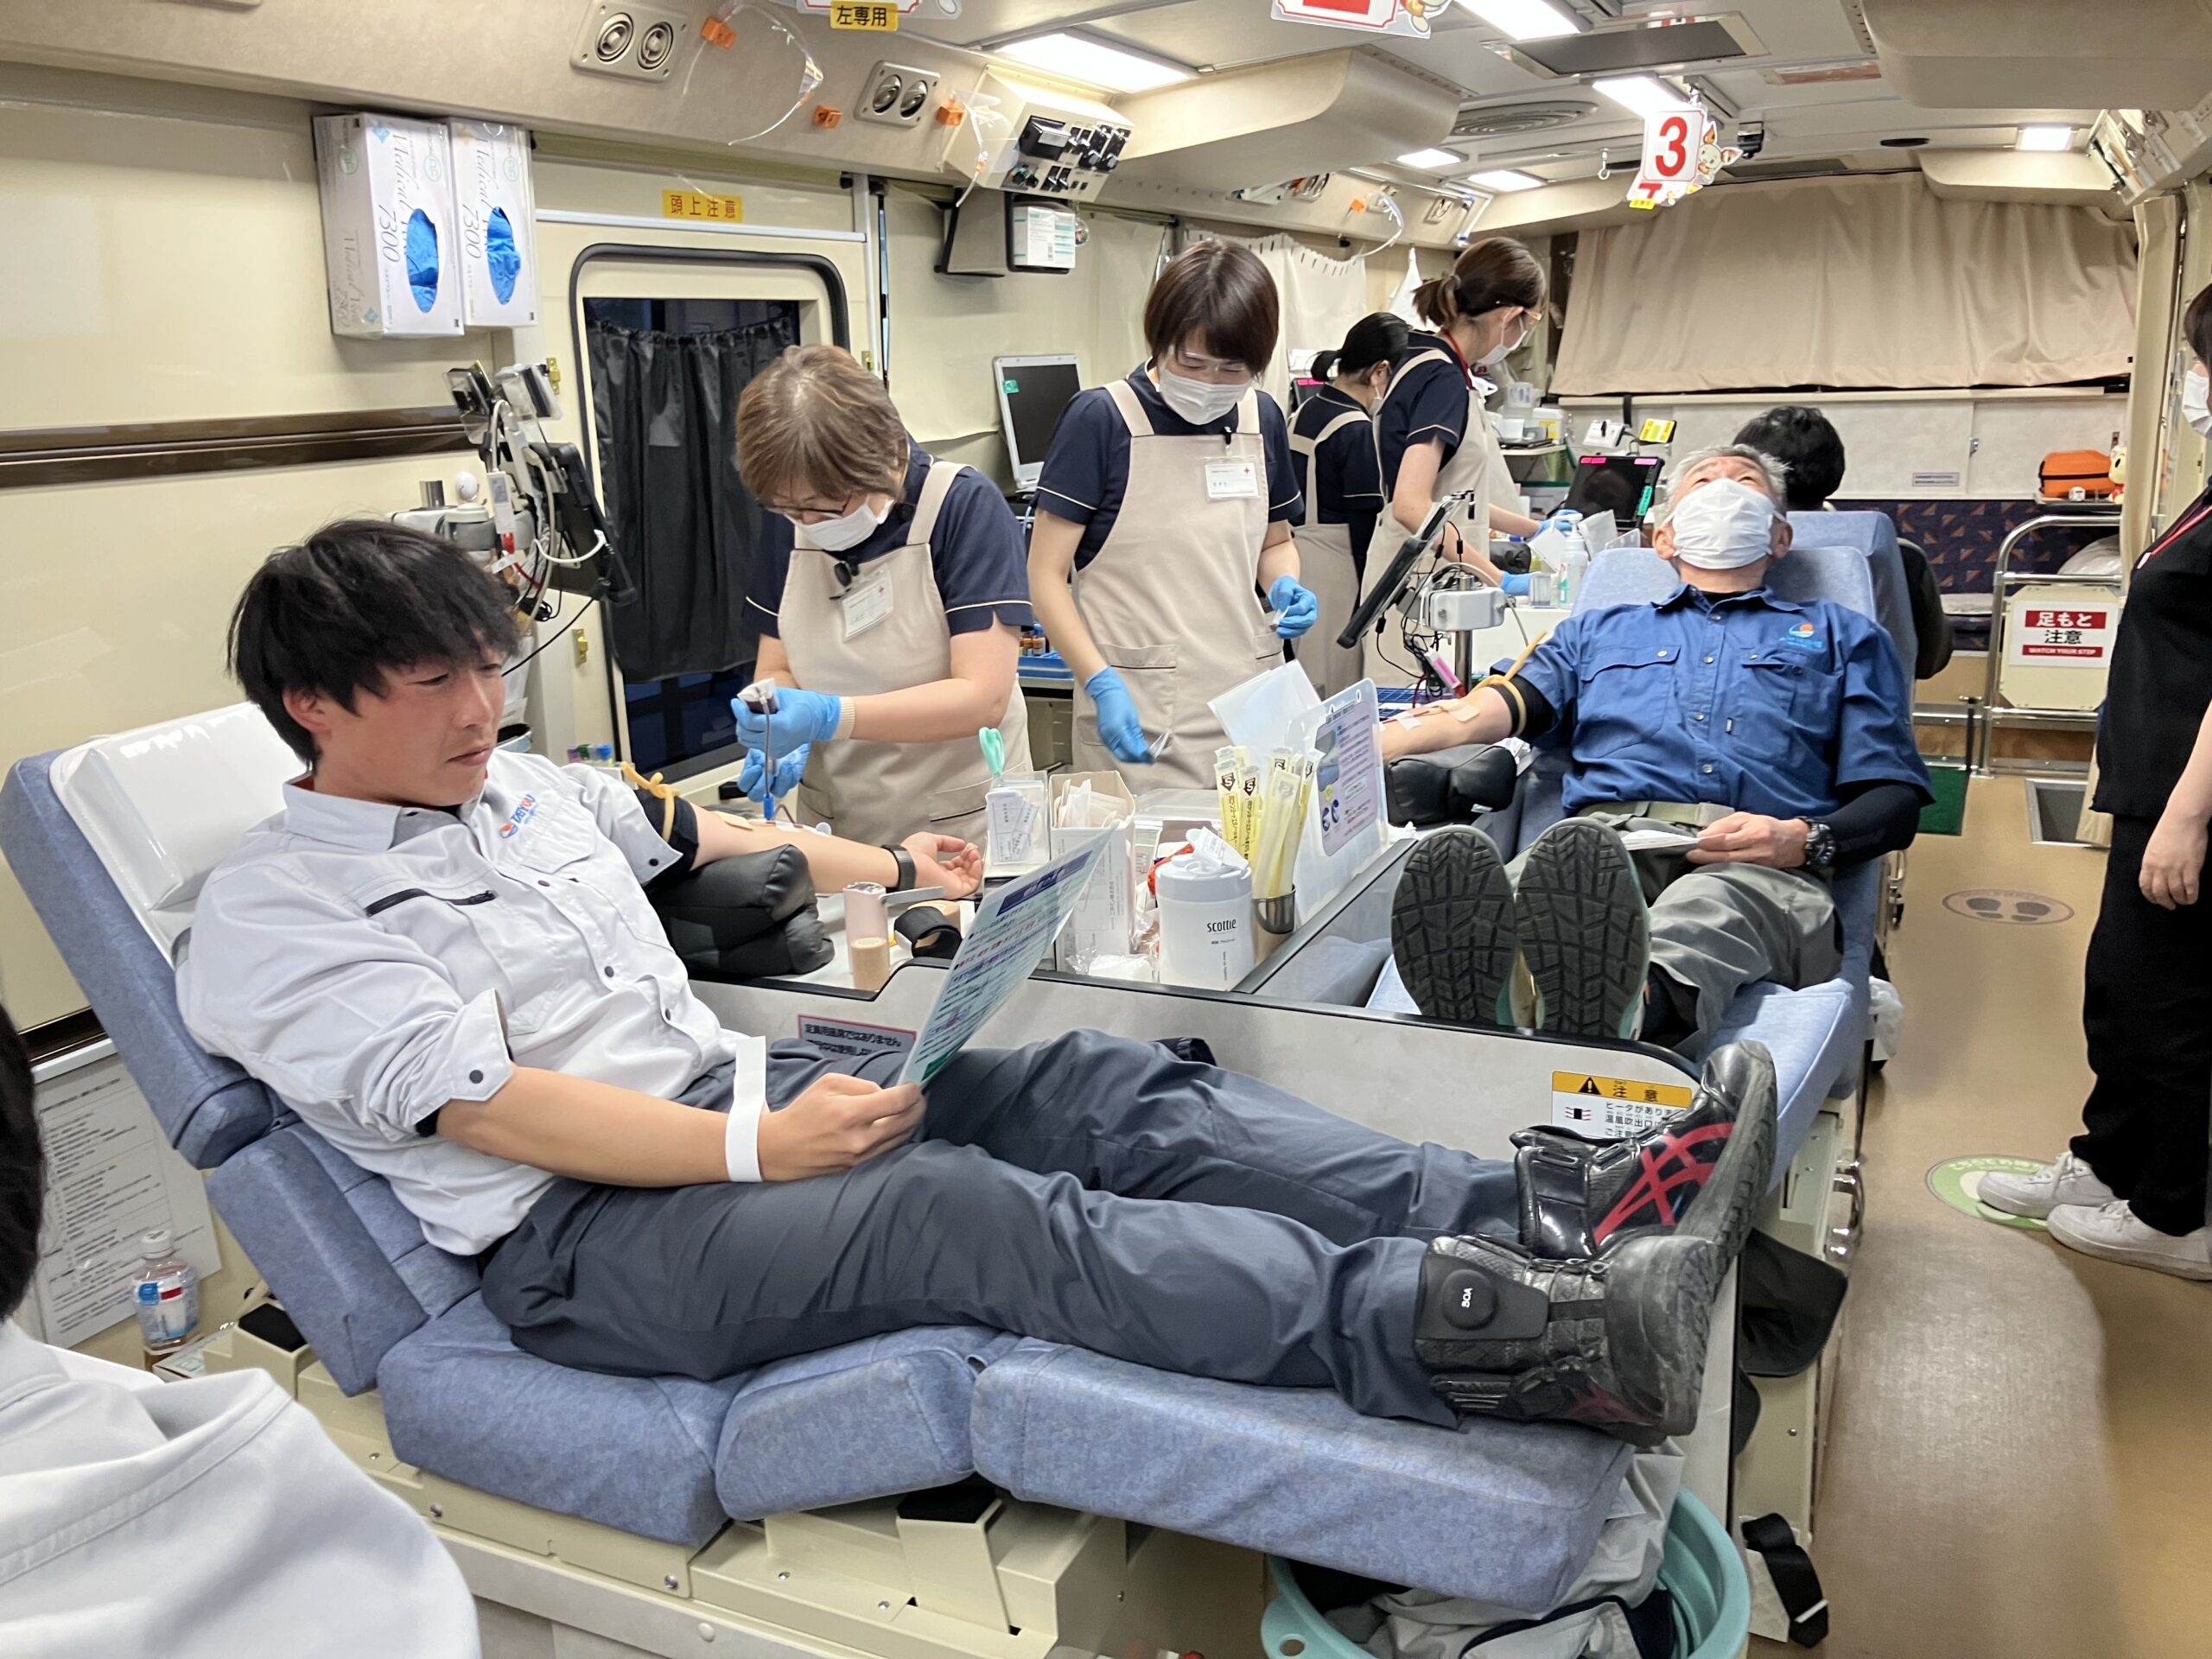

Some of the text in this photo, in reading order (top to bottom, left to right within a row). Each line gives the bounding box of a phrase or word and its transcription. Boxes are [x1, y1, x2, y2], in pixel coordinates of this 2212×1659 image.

[836, 5, 887, 27] 左専用
[1656, 116, 1688, 177] 3
[671, 194, 735, 219] 頭上注意
[378, 204, 400, 263] 7300
[462, 204, 481, 259] 7300
[2036, 612, 2092, 627] 足もと
[2044, 630, 2082, 644] 注意
[1224, 777, 1232, 786] S
[1247, 782, 1253, 791] S
[1207, 918, 1236, 932] scottie
[1612, 1084, 1659, 1103] 注意
[1606, 1102, 1673, 1116] ヒータがありま
[1461, 1287, 1473, 1308] BOA
